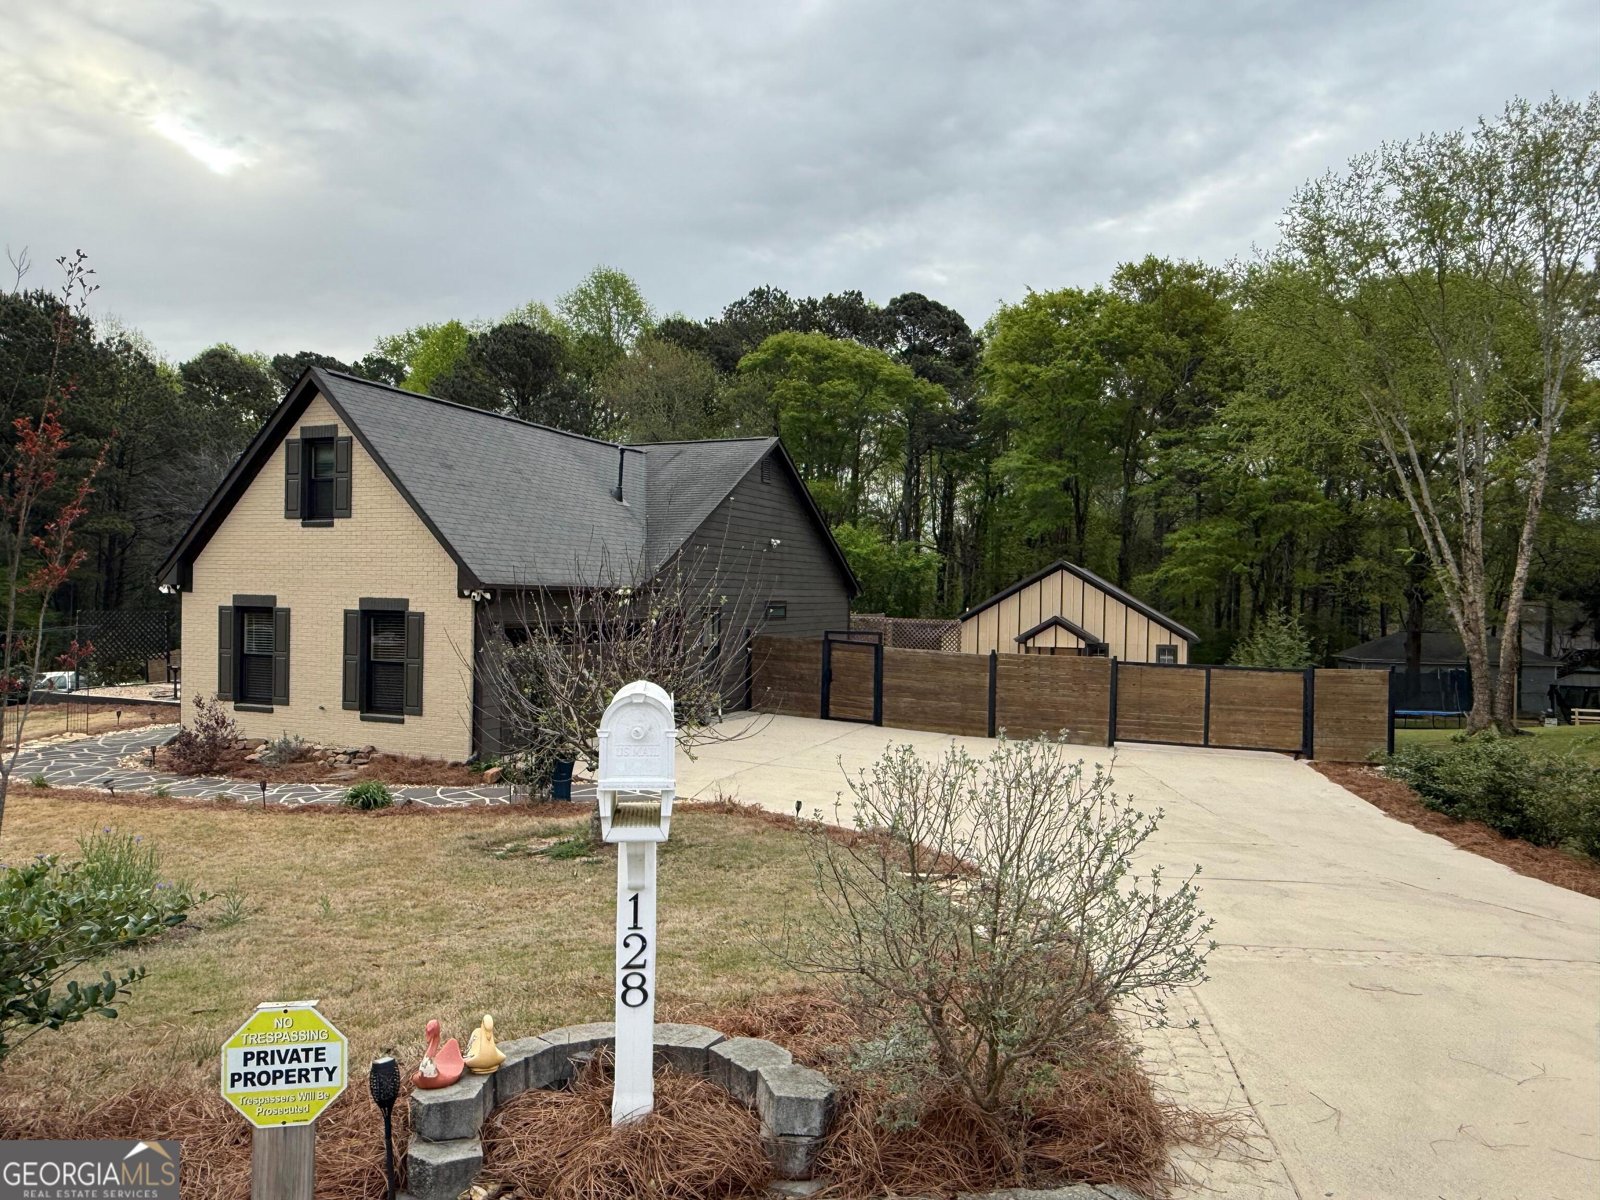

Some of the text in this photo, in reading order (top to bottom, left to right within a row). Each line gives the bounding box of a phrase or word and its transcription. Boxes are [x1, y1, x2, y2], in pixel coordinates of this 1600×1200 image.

[621, 893, 648, 1008] 128
[274, 1018, 293, 1028] NO
[242, 1030, 329, 1045] TRESPASSING
[243, 1047, 326, 1067] PRIVATE
[230, 1066, 338, 1088] PROPERTY
[240, 1090, 330, 1106] Trespassers Will Be
[256, 1104, 310, 1117] Prosecuted
